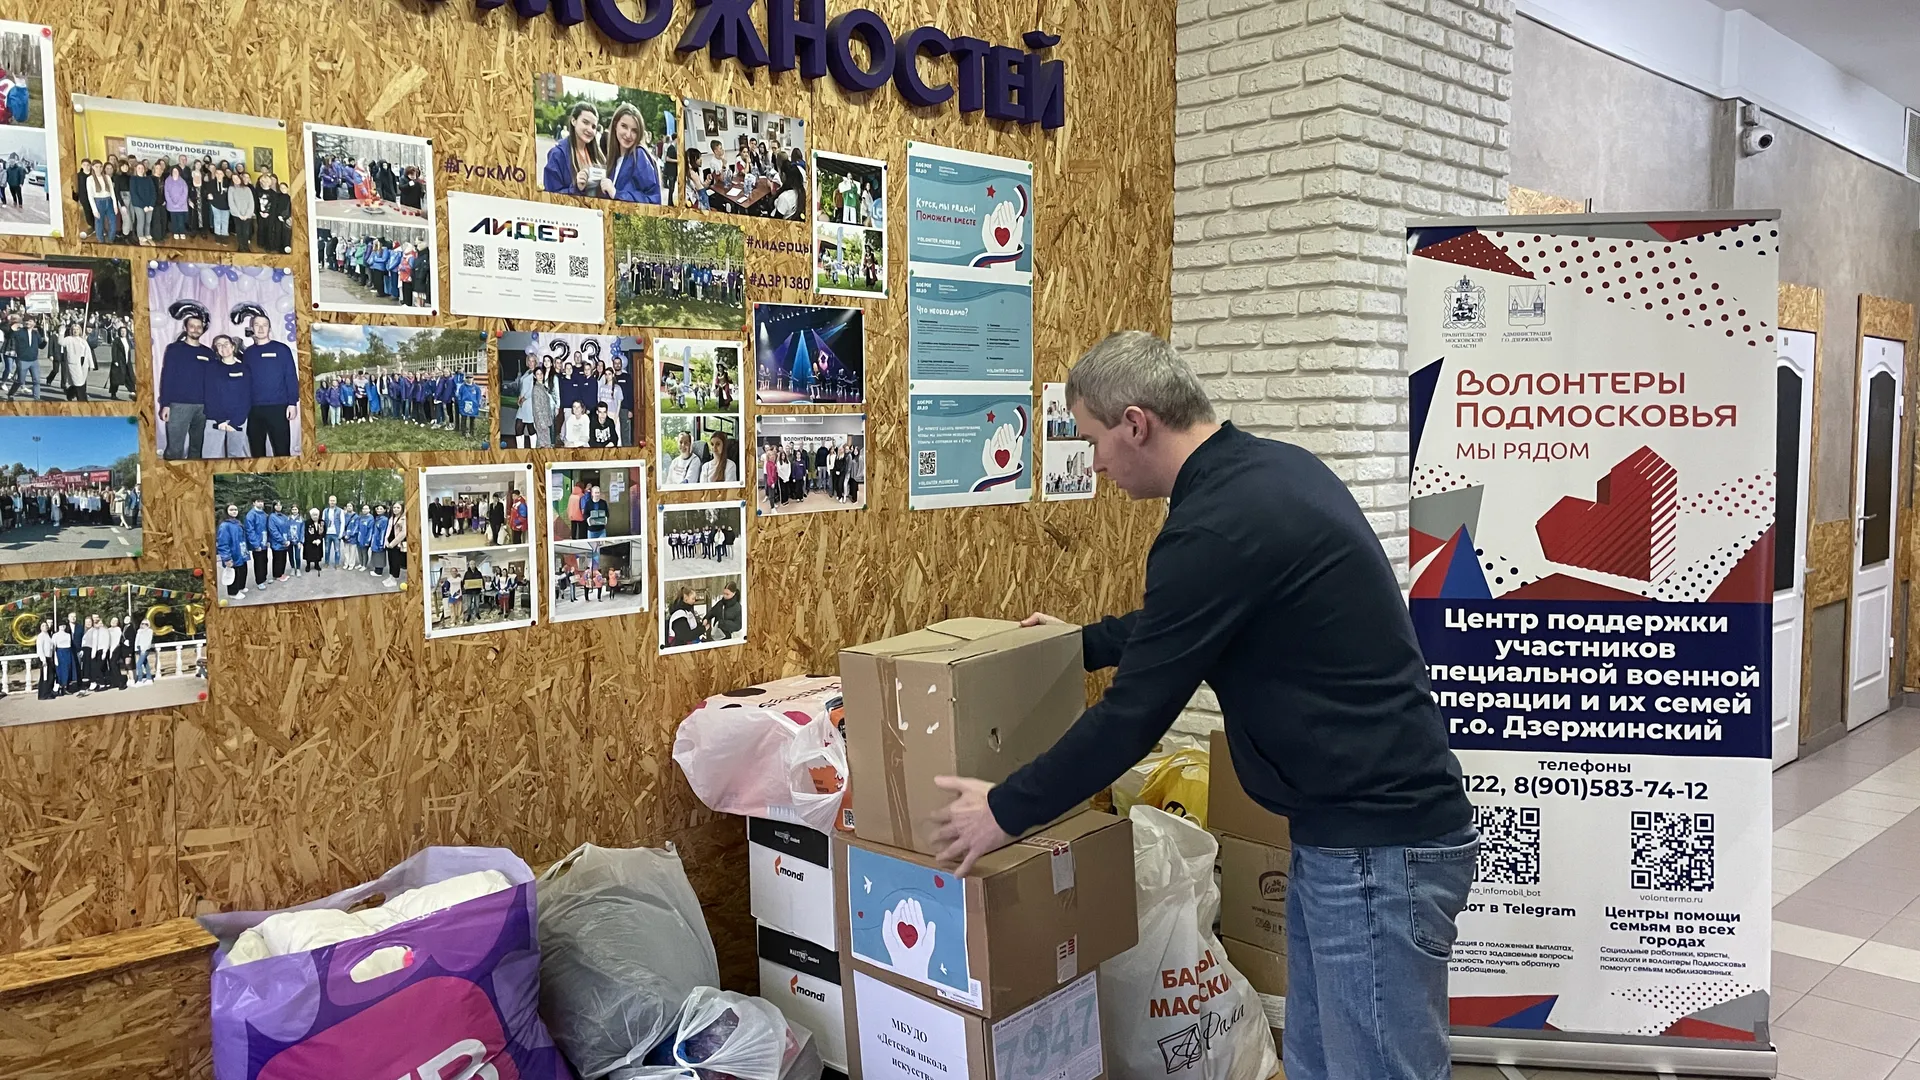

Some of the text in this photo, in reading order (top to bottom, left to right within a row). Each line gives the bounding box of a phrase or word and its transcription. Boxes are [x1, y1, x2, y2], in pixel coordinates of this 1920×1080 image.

[131, 140, 220, 156] ВОЛОНТЁРЫ ПОБЕДЫ
[468, 217, 579, 243] ЛИДЕР
[749, 272, 811, 290] #ДЗР1380
[1444, 608, 1729, 636] Центр поддержки
[1495, 638, 1676, 660] участников
[1626, 665, 1760, 688] военной
[1581, 694, 1599, 711] и
[1610, 695, 1646, 712] их
[1654, 692, 1751, 715] семей
[1450, 715, 1723, 741] г.о. Дзержинский
[1538, 759, 1632, 775] телефоны
[1514, 776, 1708, 801] 8(901)583-74-12
[780, 867, 805, 882] mondi
[1639, 894, 1703, 904] volontermo.ru
[1490, 904, 1499, 913] в
[1503, 903, 1576, 918] Telegram
[1605, 906, 1741, 923] Центры помощи
[1610, 921, 1736, 936] семьям во всех
[1536, 944, 1574, 952] выплатах,
[1639, 936, 1706, 948] городах
[1600, 946, 1730, 960] Социальные работники, юристы,
[1521, 960, 1560, 969] обратную
[1600, 956, 1641, 964] психологи
[1648, 959, 1691, 967] волонтеры
[1692, 959, 1747, 968] Подмосковья
[1460, 966, 1508, 975] обращение.
[1600, 965, 1632, 973] помогут
[1665, 967, 1734, 977] мобилизованных.
[797, 985, 826, 1003] mondi
[877, 1033, 948, 1073] «Детская школа
